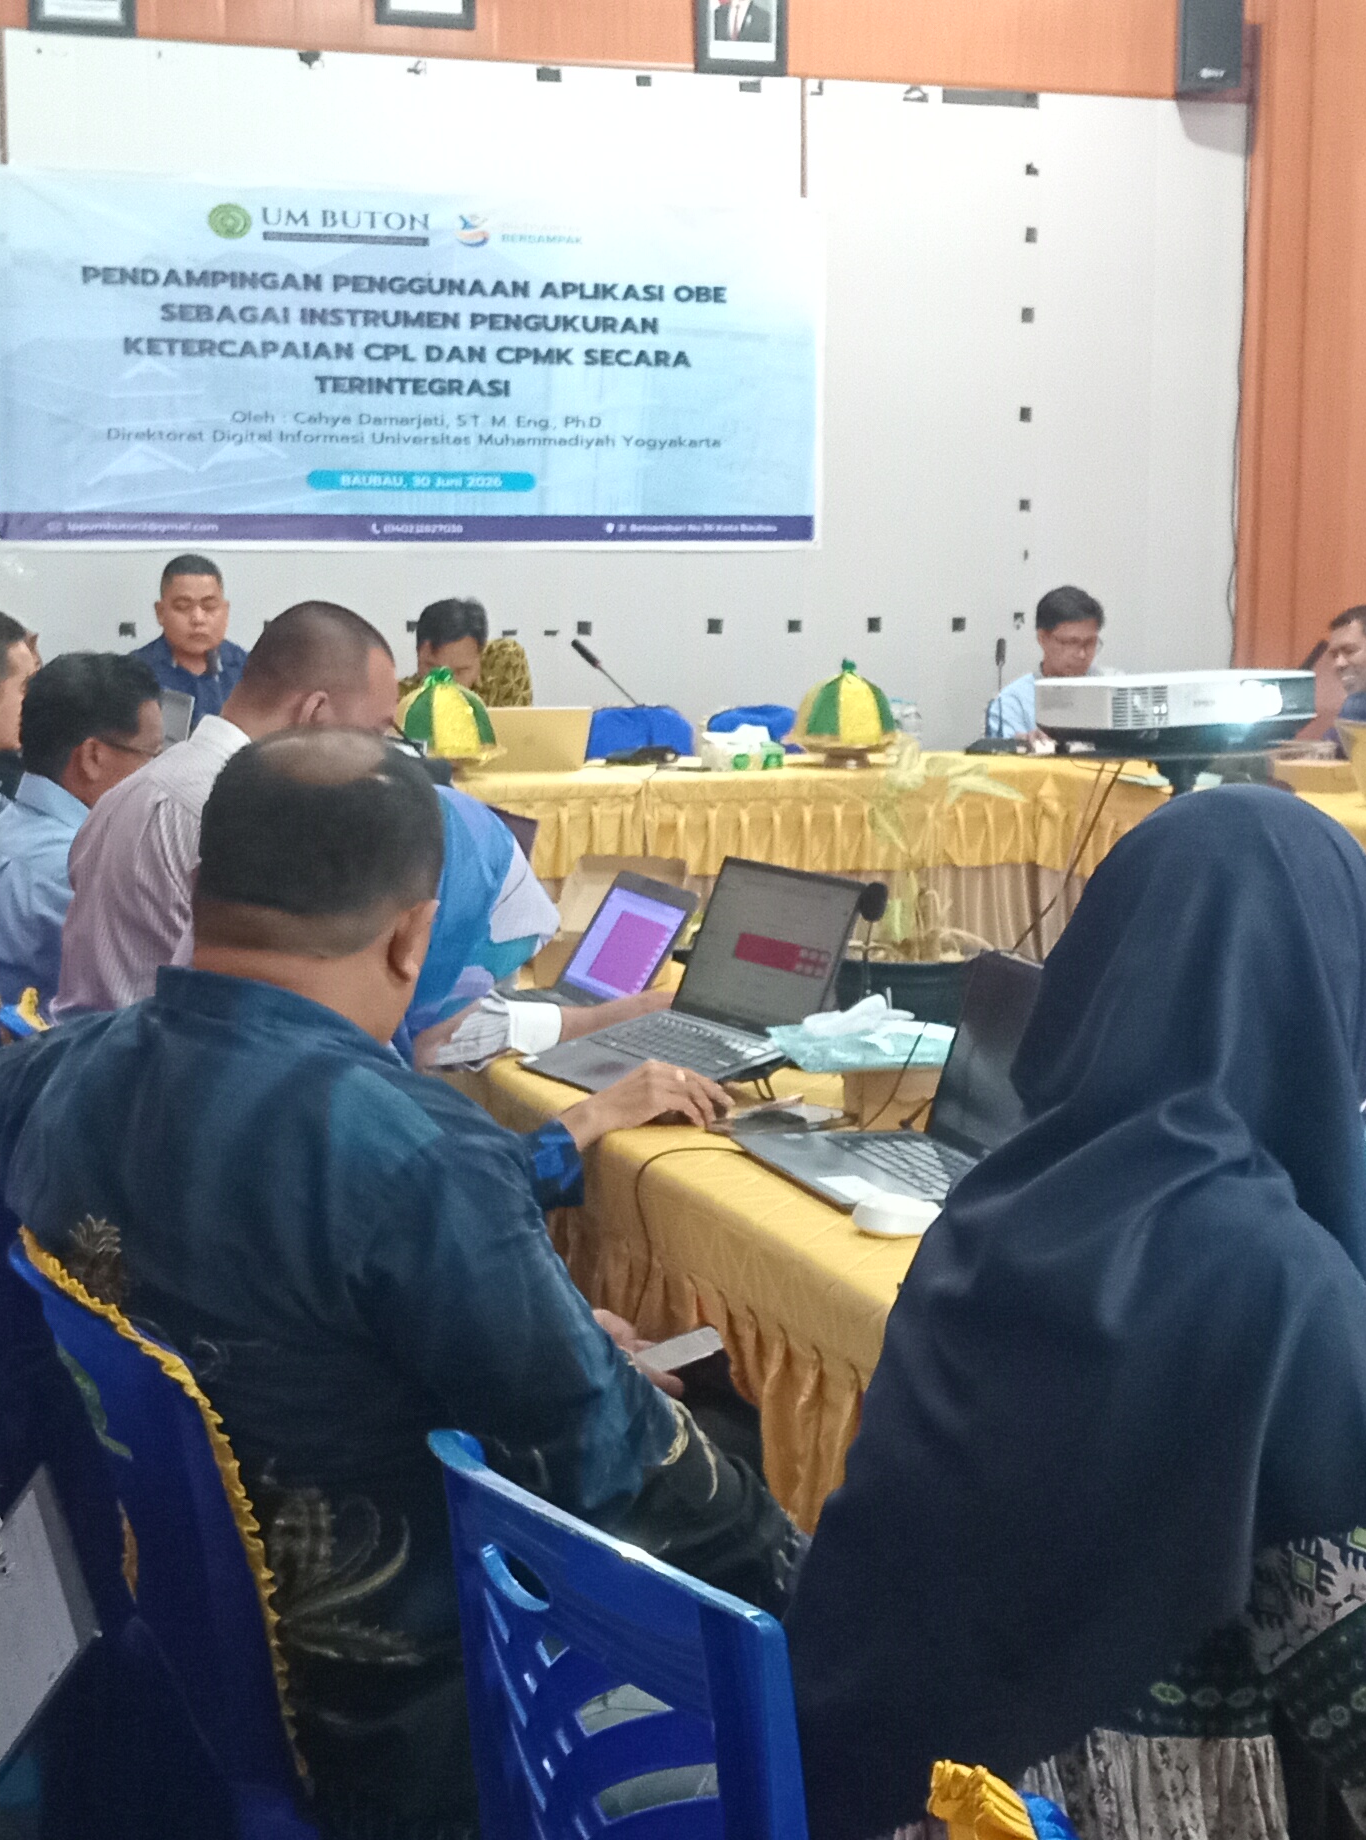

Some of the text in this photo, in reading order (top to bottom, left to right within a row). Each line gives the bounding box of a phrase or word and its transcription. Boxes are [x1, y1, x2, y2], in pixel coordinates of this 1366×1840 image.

[261, 206, 430, 231] UM BUTON
[81, 265, 727, 304] PENDAMPINGAN PENGGUNAAN APLIKASI OBE
[160, 302, 660, 335] SEBAGAI INSTRUMEN PENGUKURAN
[122, 335, 692, 369] KETERCAPAIAN CPL DAN CPMK SECARA
[314, 374, 512, 398] TERINTEGRASI
[231, 410, 275, 424] Oleh
[293, 411, 352, 428] Cahya
[106, 427, 721, 451] Direktorat Digital Informasi Universitas Muhammadiyah Yogyakarta
